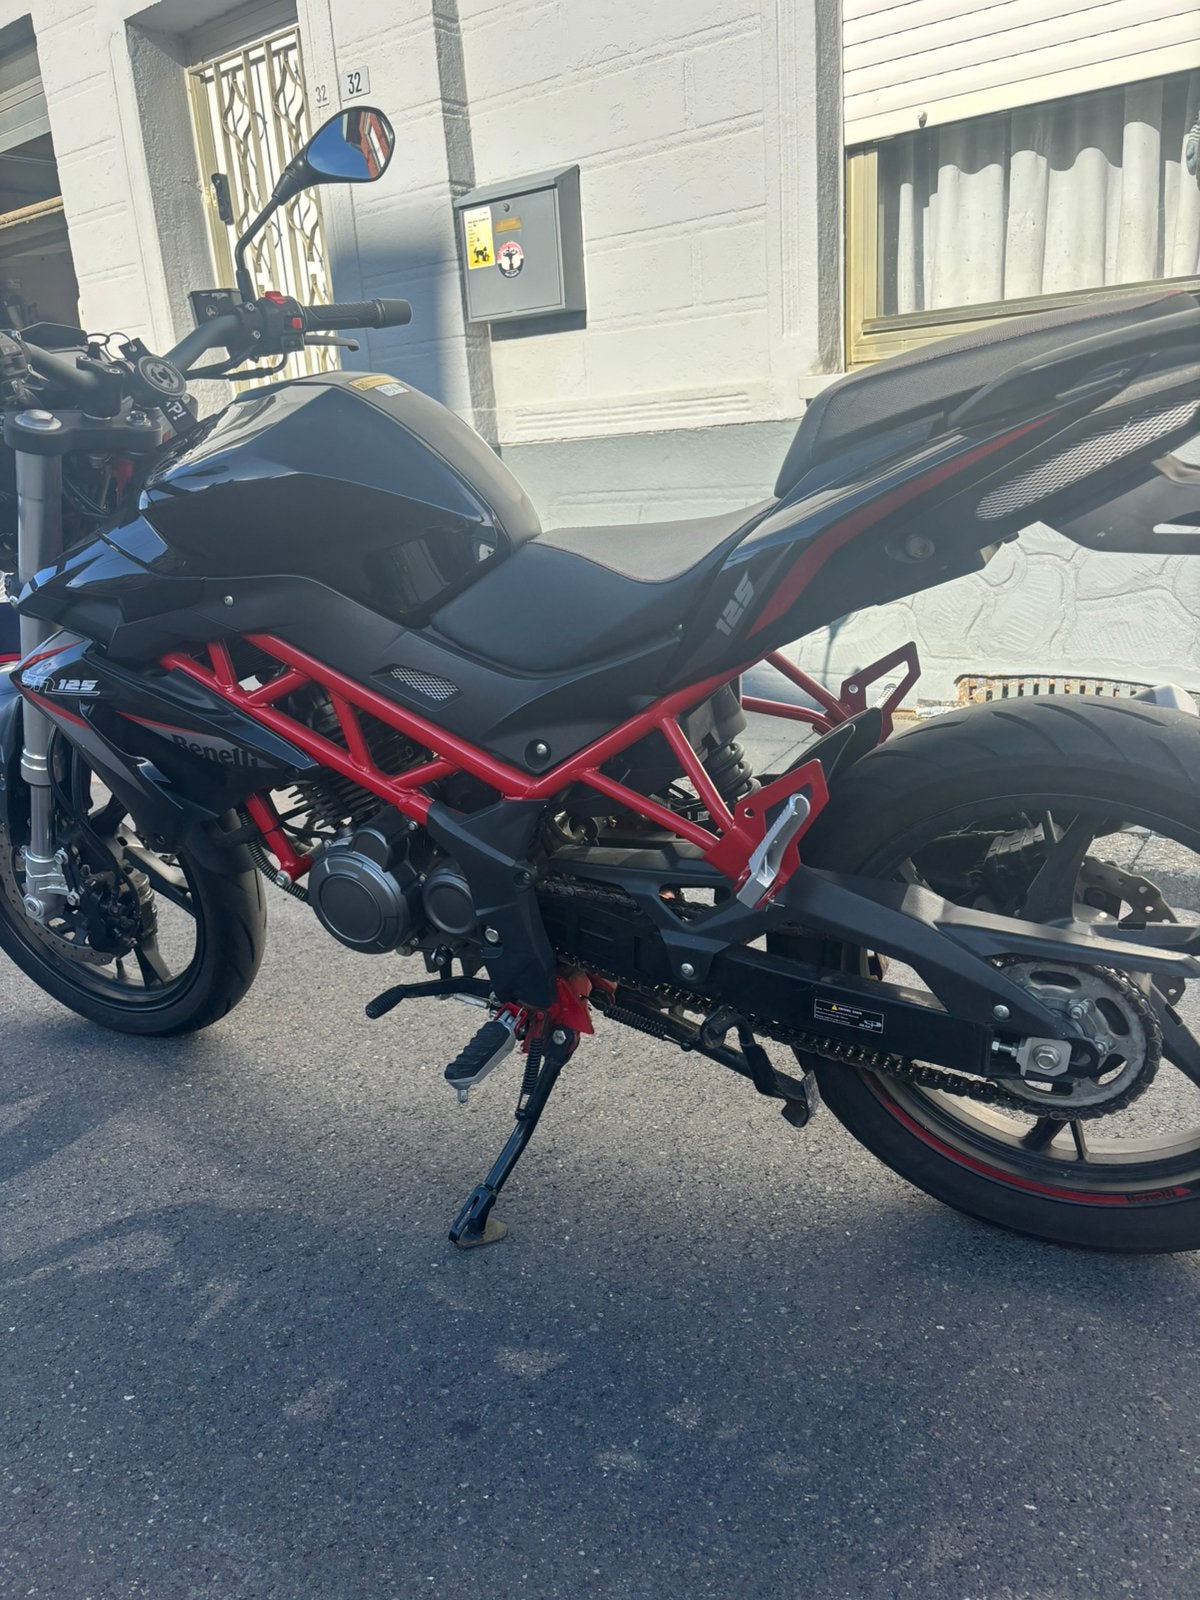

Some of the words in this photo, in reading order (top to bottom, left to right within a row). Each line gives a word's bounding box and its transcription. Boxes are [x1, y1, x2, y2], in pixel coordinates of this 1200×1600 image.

[315, 84, 327, 103] 32
[345, 72, 362, 94] 32
[715, 569, 754, 637] 125
[58, 679, 98, 691] 125
[171, 733, 259, 769] Benelli
